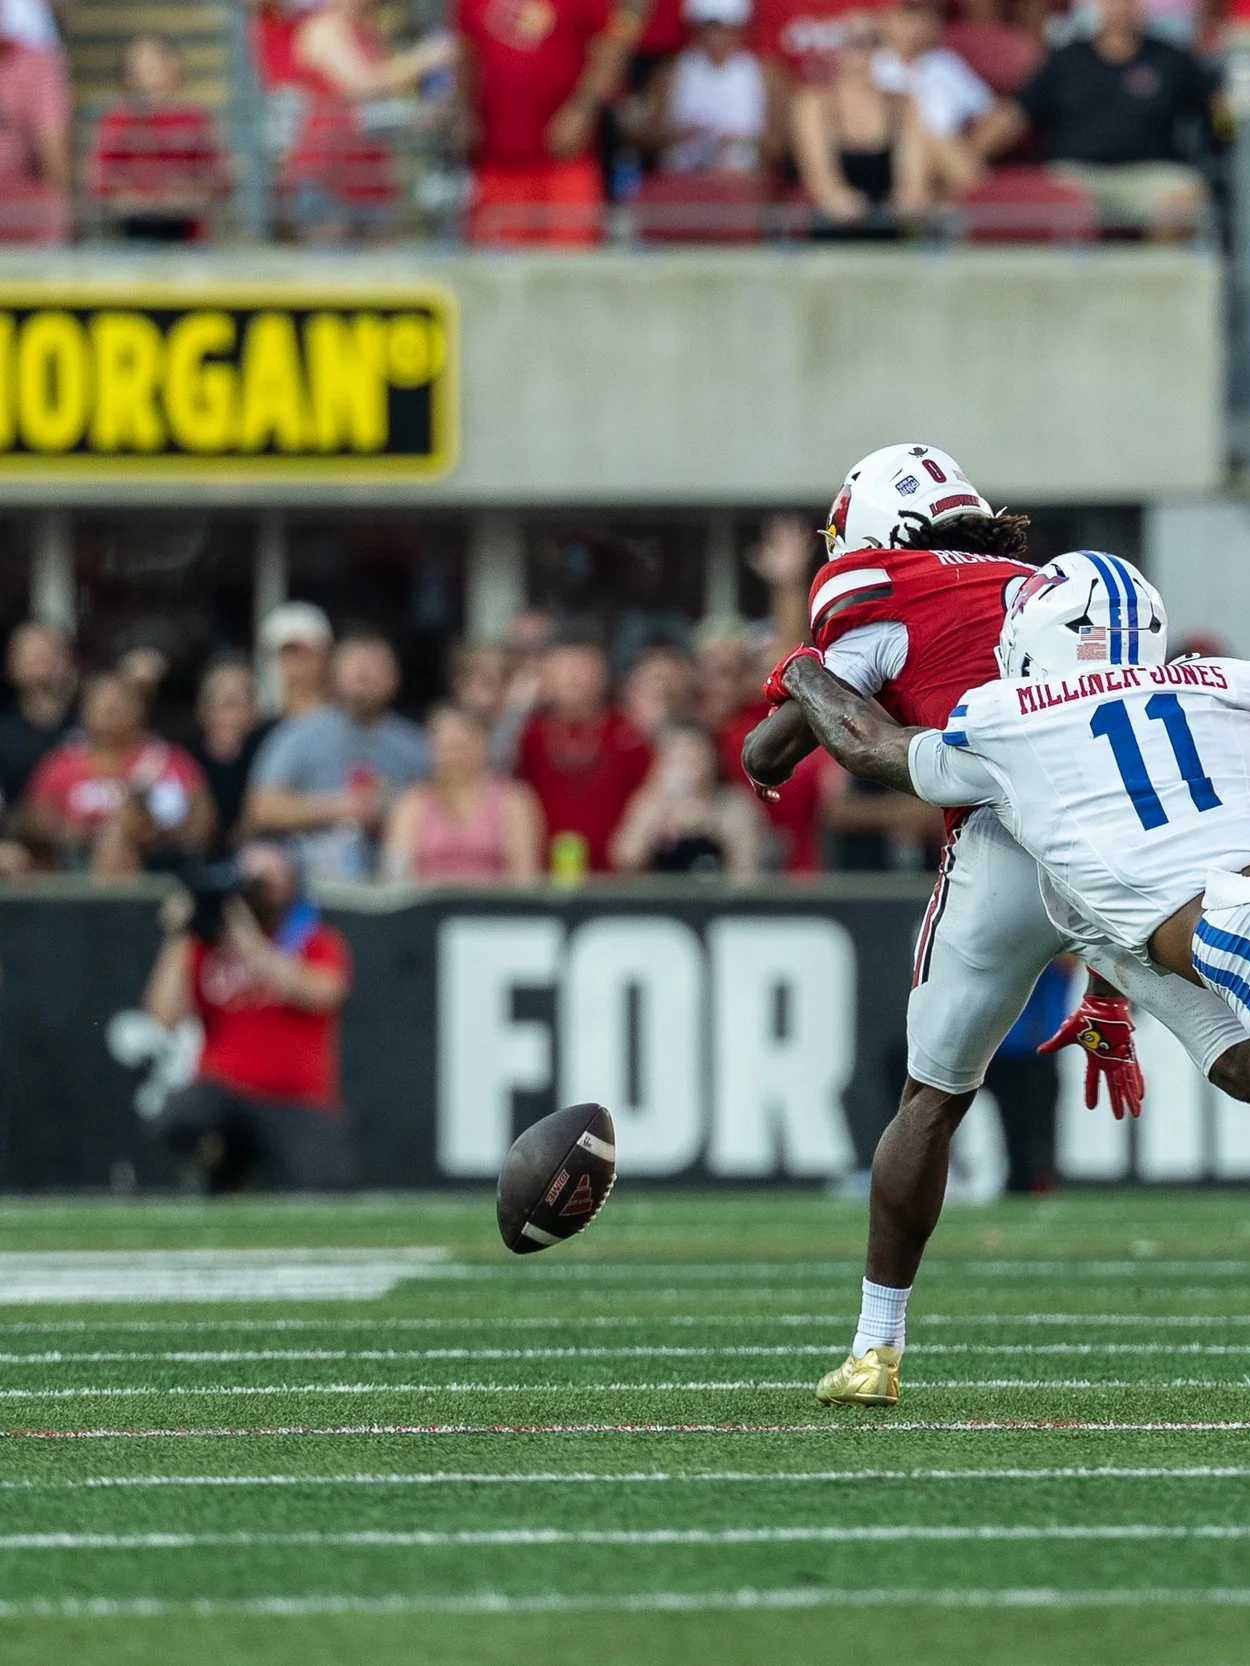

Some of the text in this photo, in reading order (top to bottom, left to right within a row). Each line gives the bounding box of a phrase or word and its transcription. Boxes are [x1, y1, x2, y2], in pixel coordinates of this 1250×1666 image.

[0, 311, 390, 453] ORGAN
[1089, 693, 1223, 831] 11
[436, 914, 859, 1178] FOR
